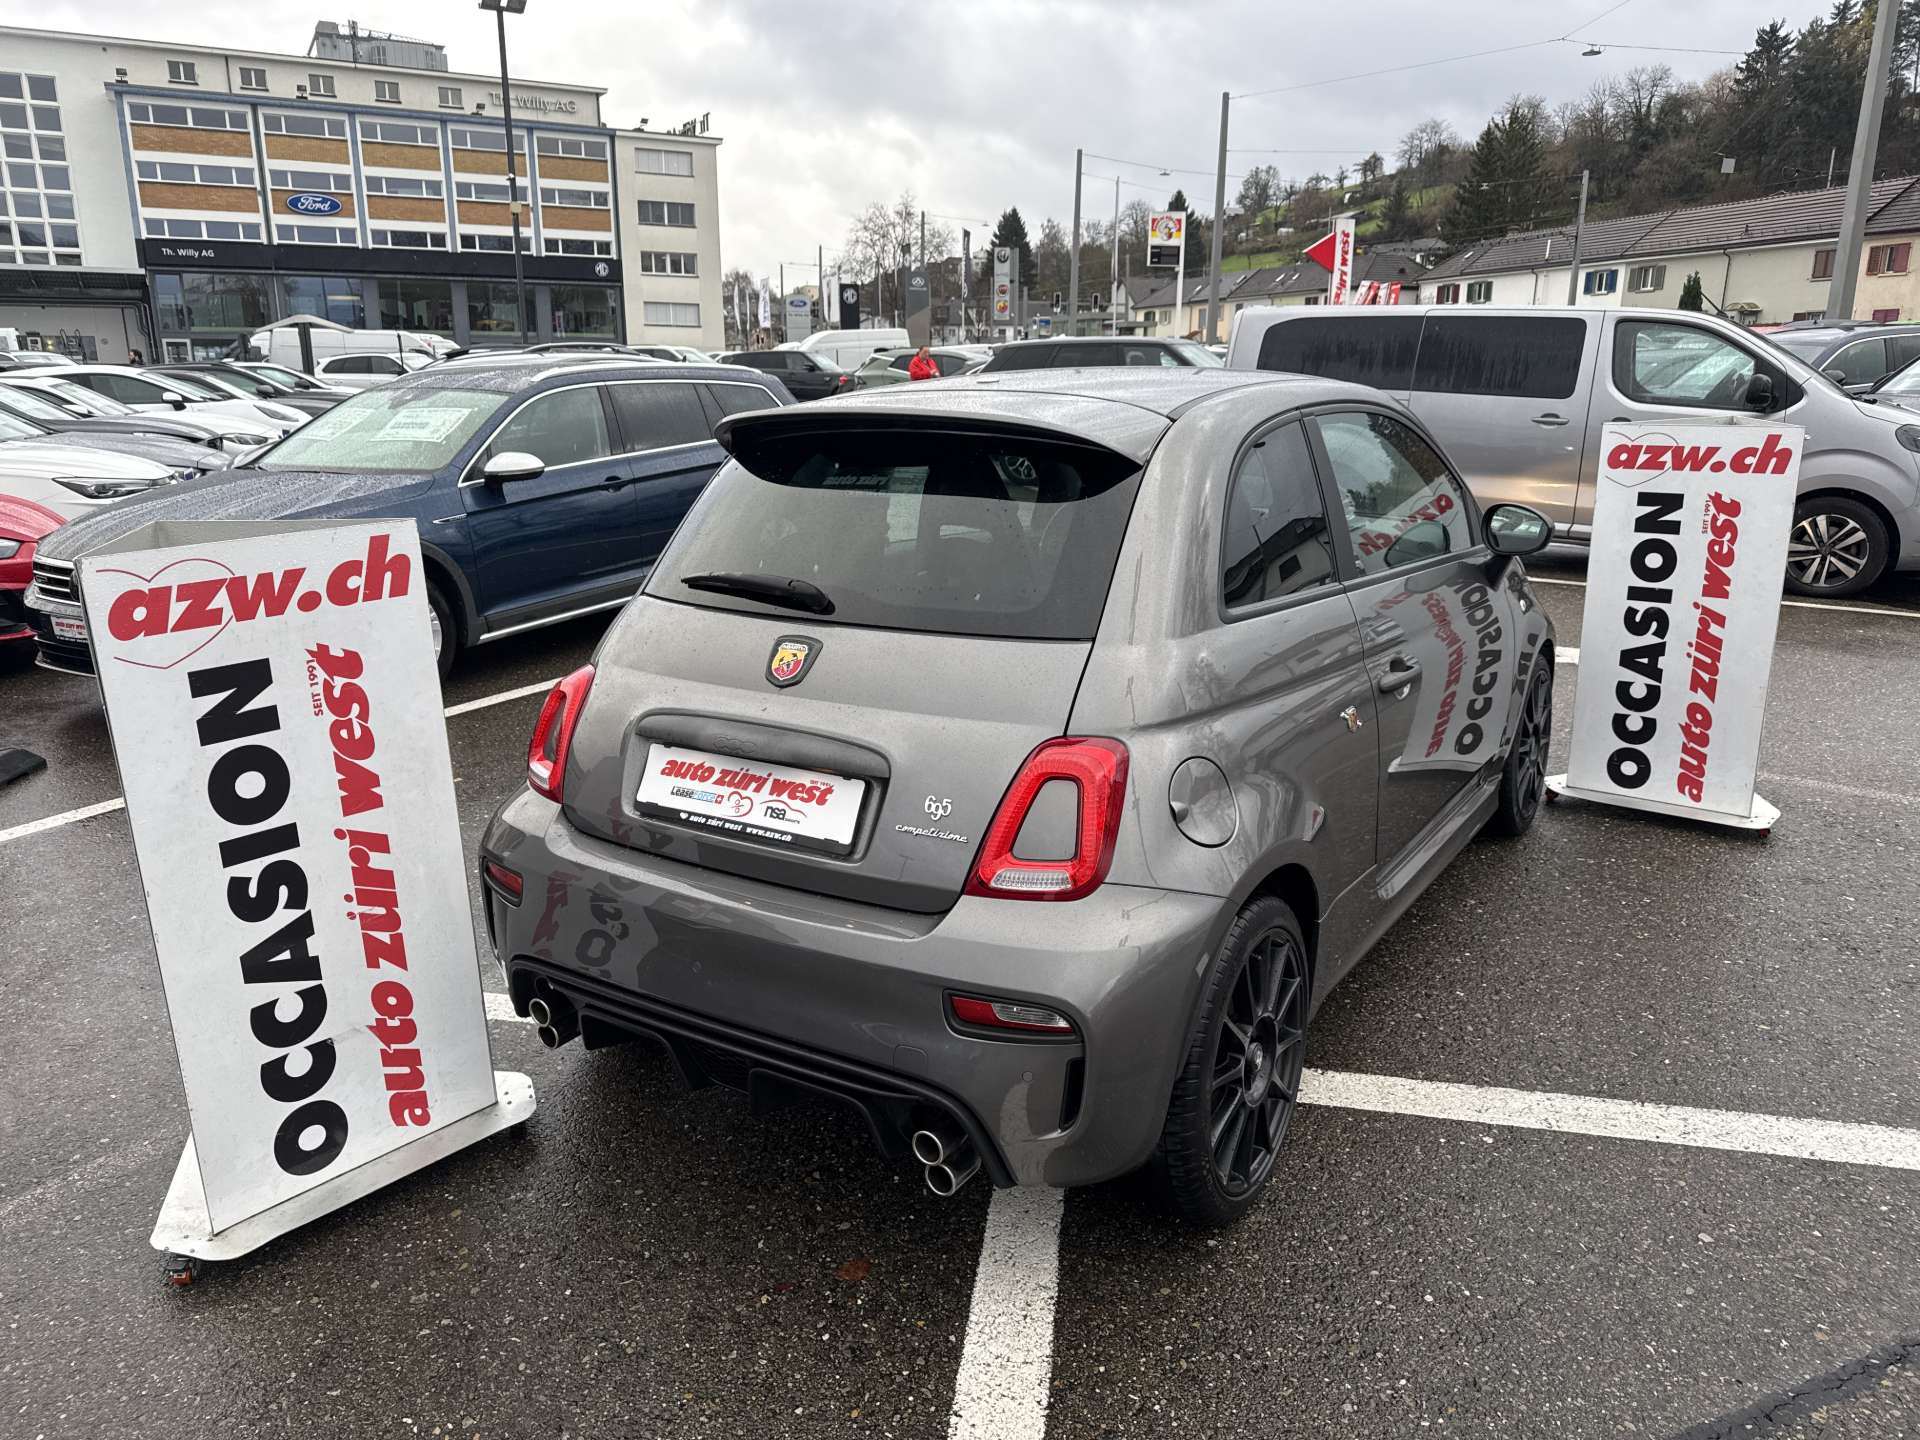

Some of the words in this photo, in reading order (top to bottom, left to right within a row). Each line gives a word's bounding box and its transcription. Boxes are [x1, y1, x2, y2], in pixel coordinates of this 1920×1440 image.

[518, 95, 550, 112] Willy
[556, 101, 577, 112] AG
[297, 195, 332, 211] Ford
[161, 248, 175, 256] Th.
[177, 248, 199, 258] Willy
[201, 249, 214, 257] AG
[595, 262, 609, 277] MG
[843, 288, 857, 304] MG
[1607, 434, 1793, 475] azw.ch
[1703, 500, 1711, 517] 1991
[1701, 519, 1709, 535] SEIT
[1701, 491, 1741, 600] west
[107, 534, 411, 641] azw.ch
[1606, 491, 1685, 789] OCCASION
[1685, 601, 1727, 704] züri
[306, 659, 319, 687] 1991
[311, 692, 323, 717] SEIT
[304, 643, 384, 818] west
[1677, 702, 1713, 803] auto
[660, 758, 716, 784] auto
[712, 766, 772, 794] züri
[768, 778, 834, 806] west
[764, 805, 786, 821] nsa
[924, 795, 952, 821] 695
[689, 814, 706, 824] auto
[724, 822, 743, 831] west
[895, 824, 968, 843] competizione
[333, 828, 409, 972] züri
[187, 657, 349, 1176] OCCASION
[366, 981, 431, 1127] auto
